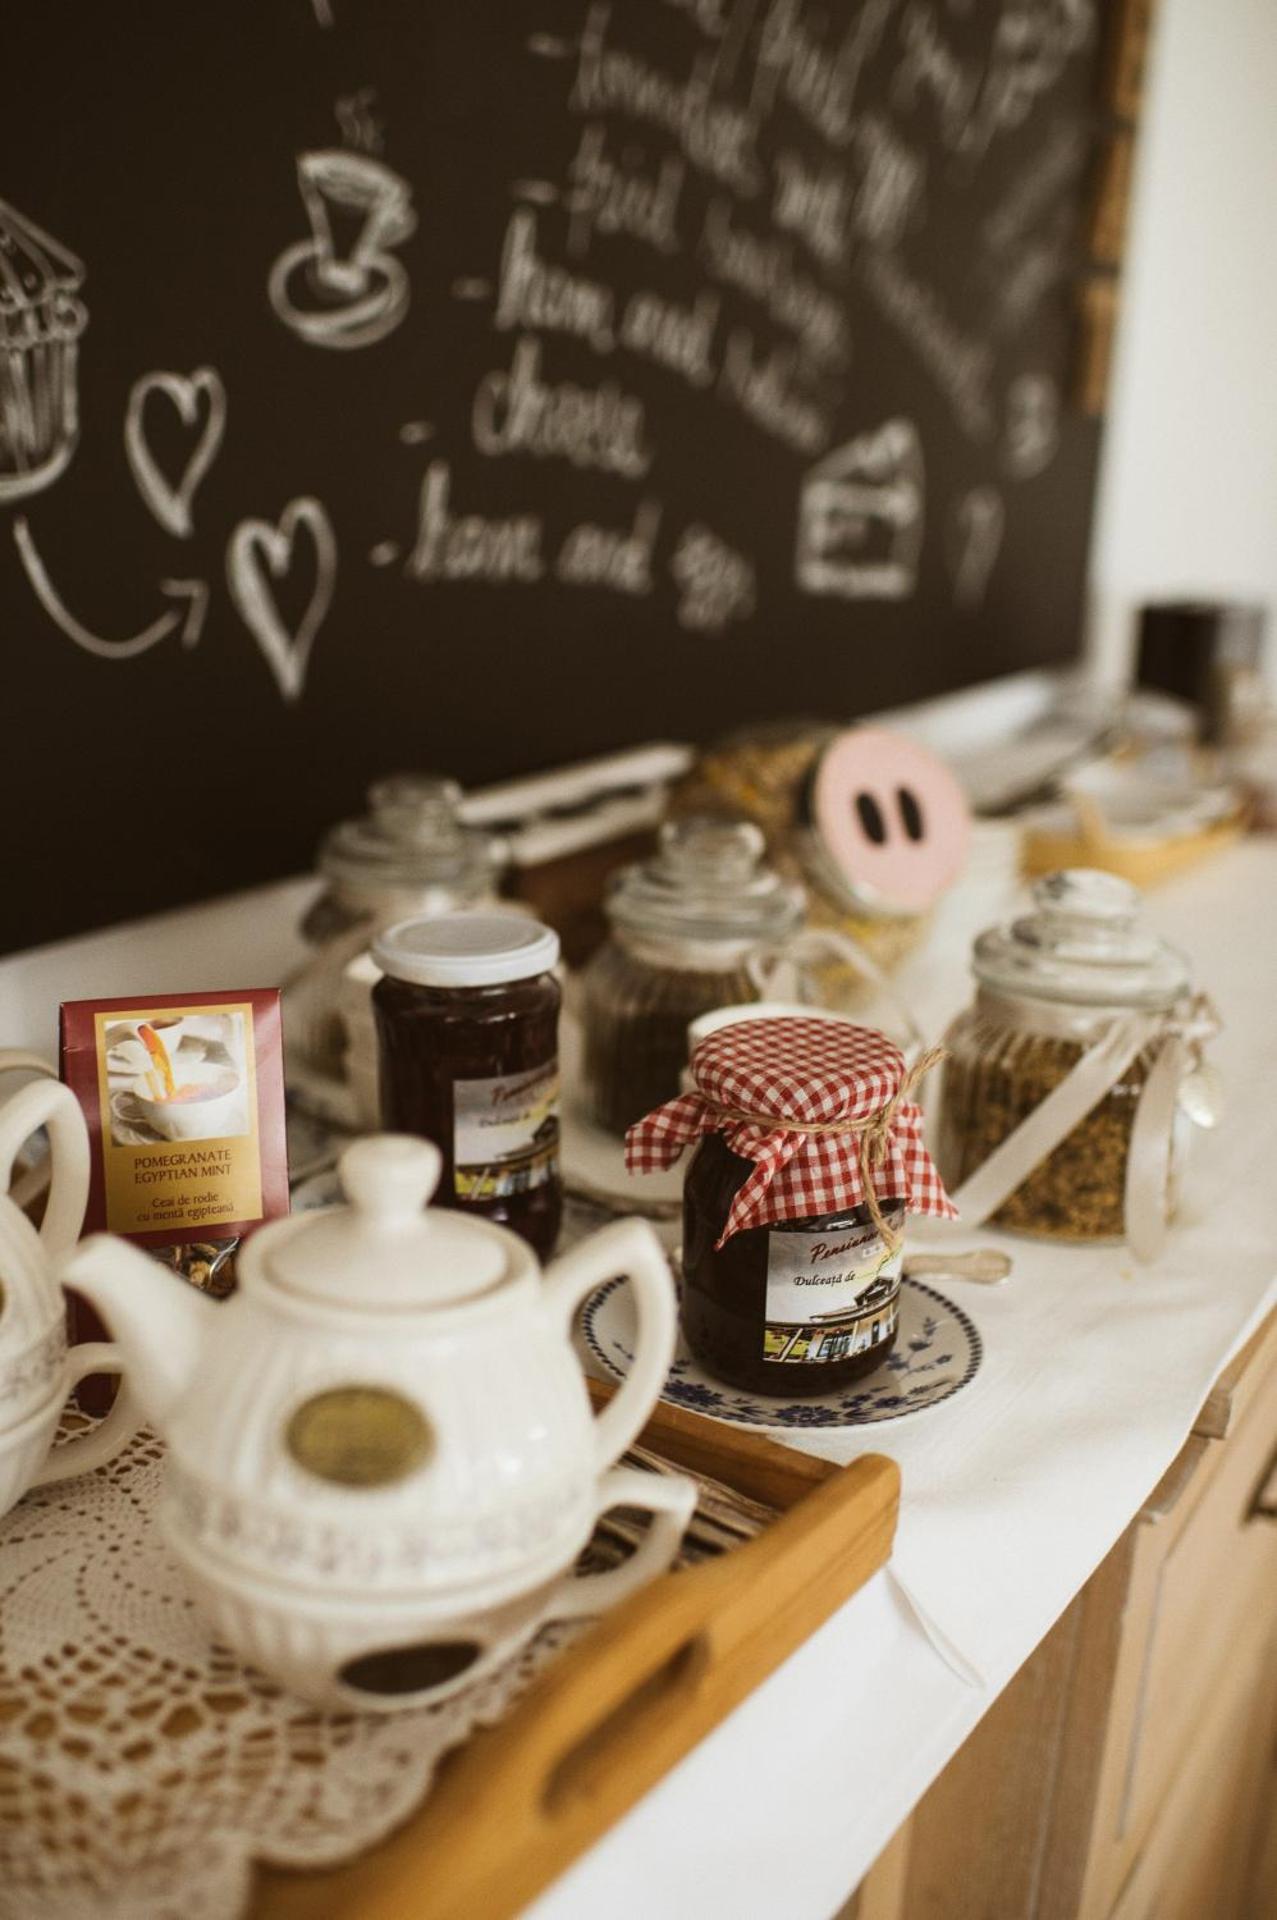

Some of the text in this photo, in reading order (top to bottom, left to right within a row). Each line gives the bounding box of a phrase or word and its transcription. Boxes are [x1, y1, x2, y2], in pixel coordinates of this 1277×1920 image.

[135, 1150, 232, 1169] POMEGRANATE
[135, 1164, 232, 1184] EGYPTIAN MINT
[152, 1191, 219, 1208] Ceai de rodie
[136, 1213, 151, 1222] cu
[845, 1270, 856, 1282] de
